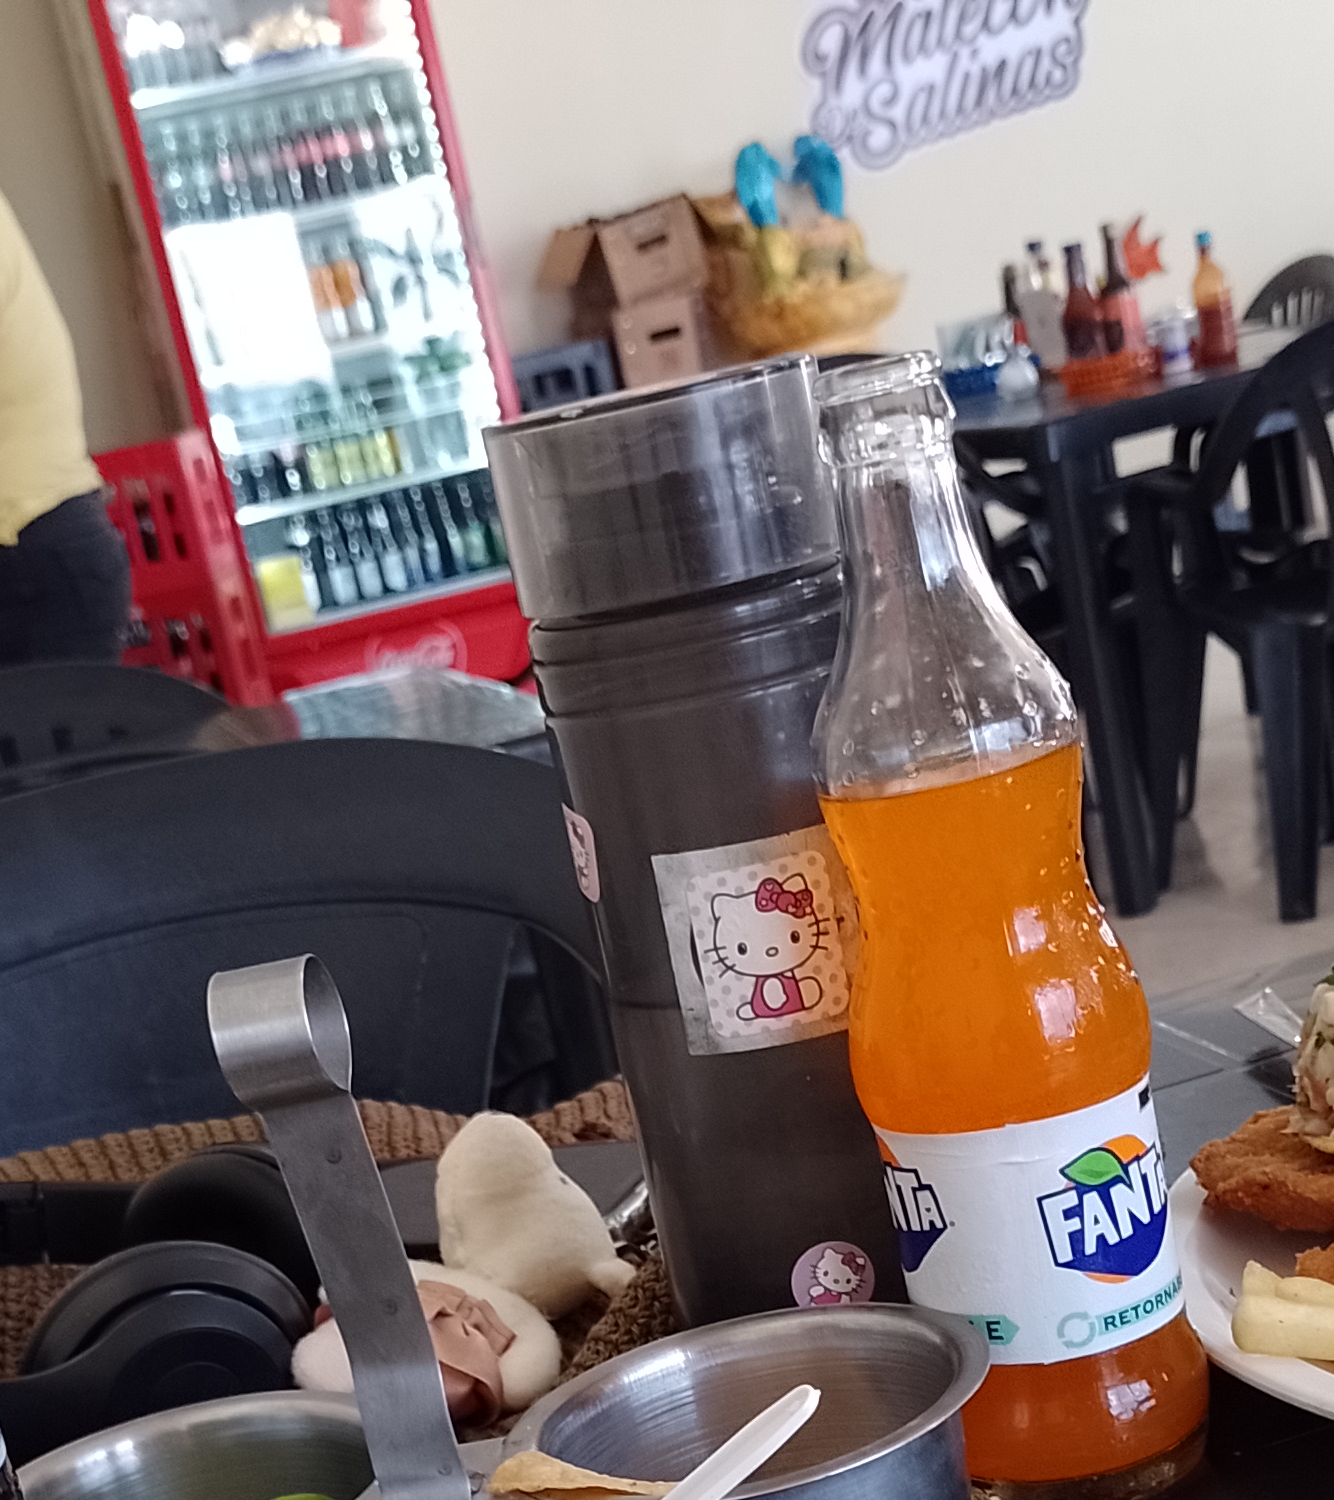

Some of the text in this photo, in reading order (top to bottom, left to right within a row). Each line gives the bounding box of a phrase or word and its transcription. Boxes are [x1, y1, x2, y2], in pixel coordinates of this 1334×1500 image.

[866, 37, 1071, 153] Salinas
[884, 1166, 945, 1231] NTA
[1041, 1146, 1167, 1264] FANTA
